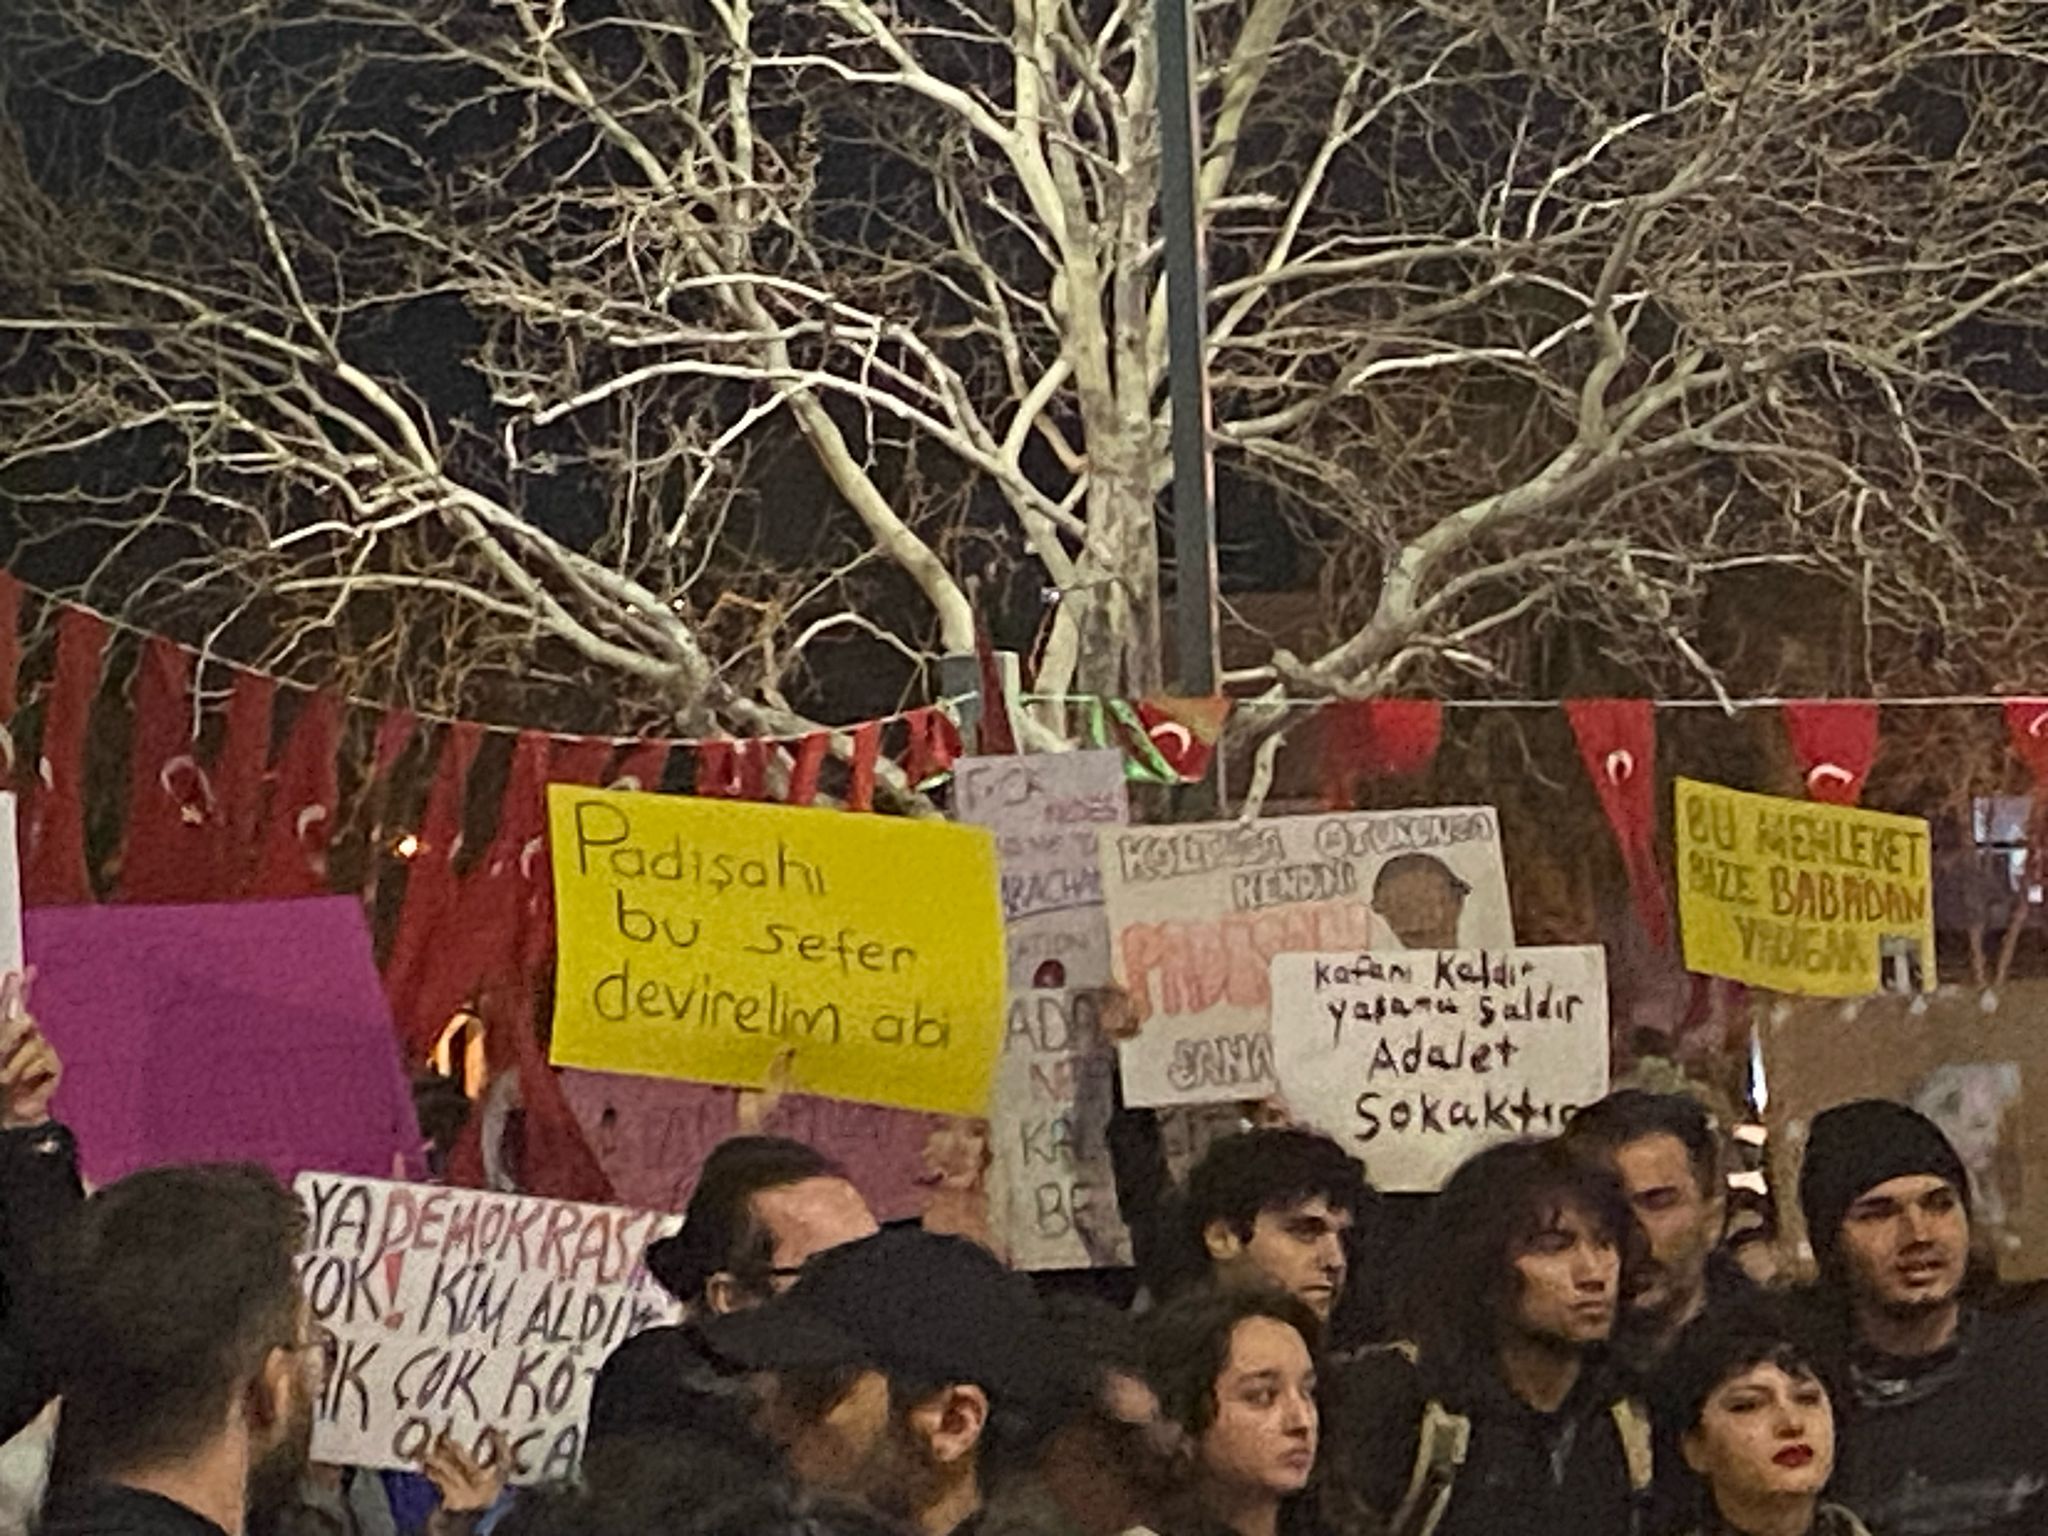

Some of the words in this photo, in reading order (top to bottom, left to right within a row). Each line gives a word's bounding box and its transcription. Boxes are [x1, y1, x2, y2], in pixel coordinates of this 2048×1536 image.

[616, 888, 699, 949] bu
[1769, 863, 1927, 924] BABADAN
[1367, 1027, 1519, 1082] Adalet
